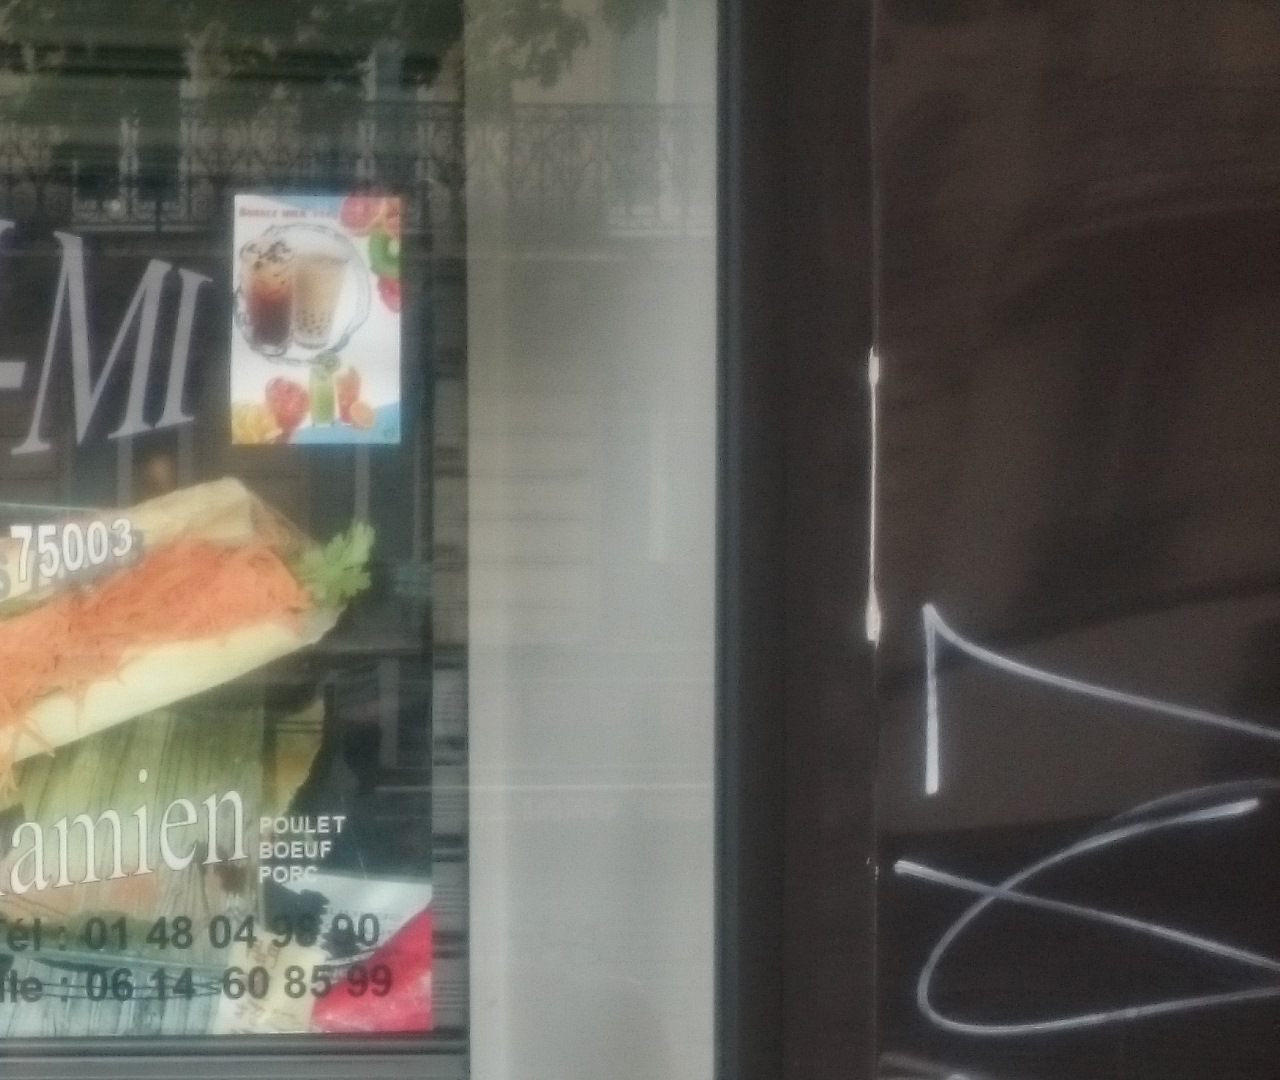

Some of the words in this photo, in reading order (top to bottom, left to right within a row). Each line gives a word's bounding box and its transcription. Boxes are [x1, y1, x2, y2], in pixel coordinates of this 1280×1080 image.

[9, 517, 134, 584] 75003
[259, 815, 347, 835] POULET
[259, 840, 333, 860] BOEUF
[259, 865, 318, 884] PORC
[85, 916, 129, 950] 01
[146, 915, 194, 950] 48
[208, 914, 257, 948] 04
[85, 967, 134, 1002] 06
[149, 967, 198, 1001] 14
[222, 965, 270, 1000] 60
[283, 964, 332, 999] 85
[346, 963, 393, 998] 99
